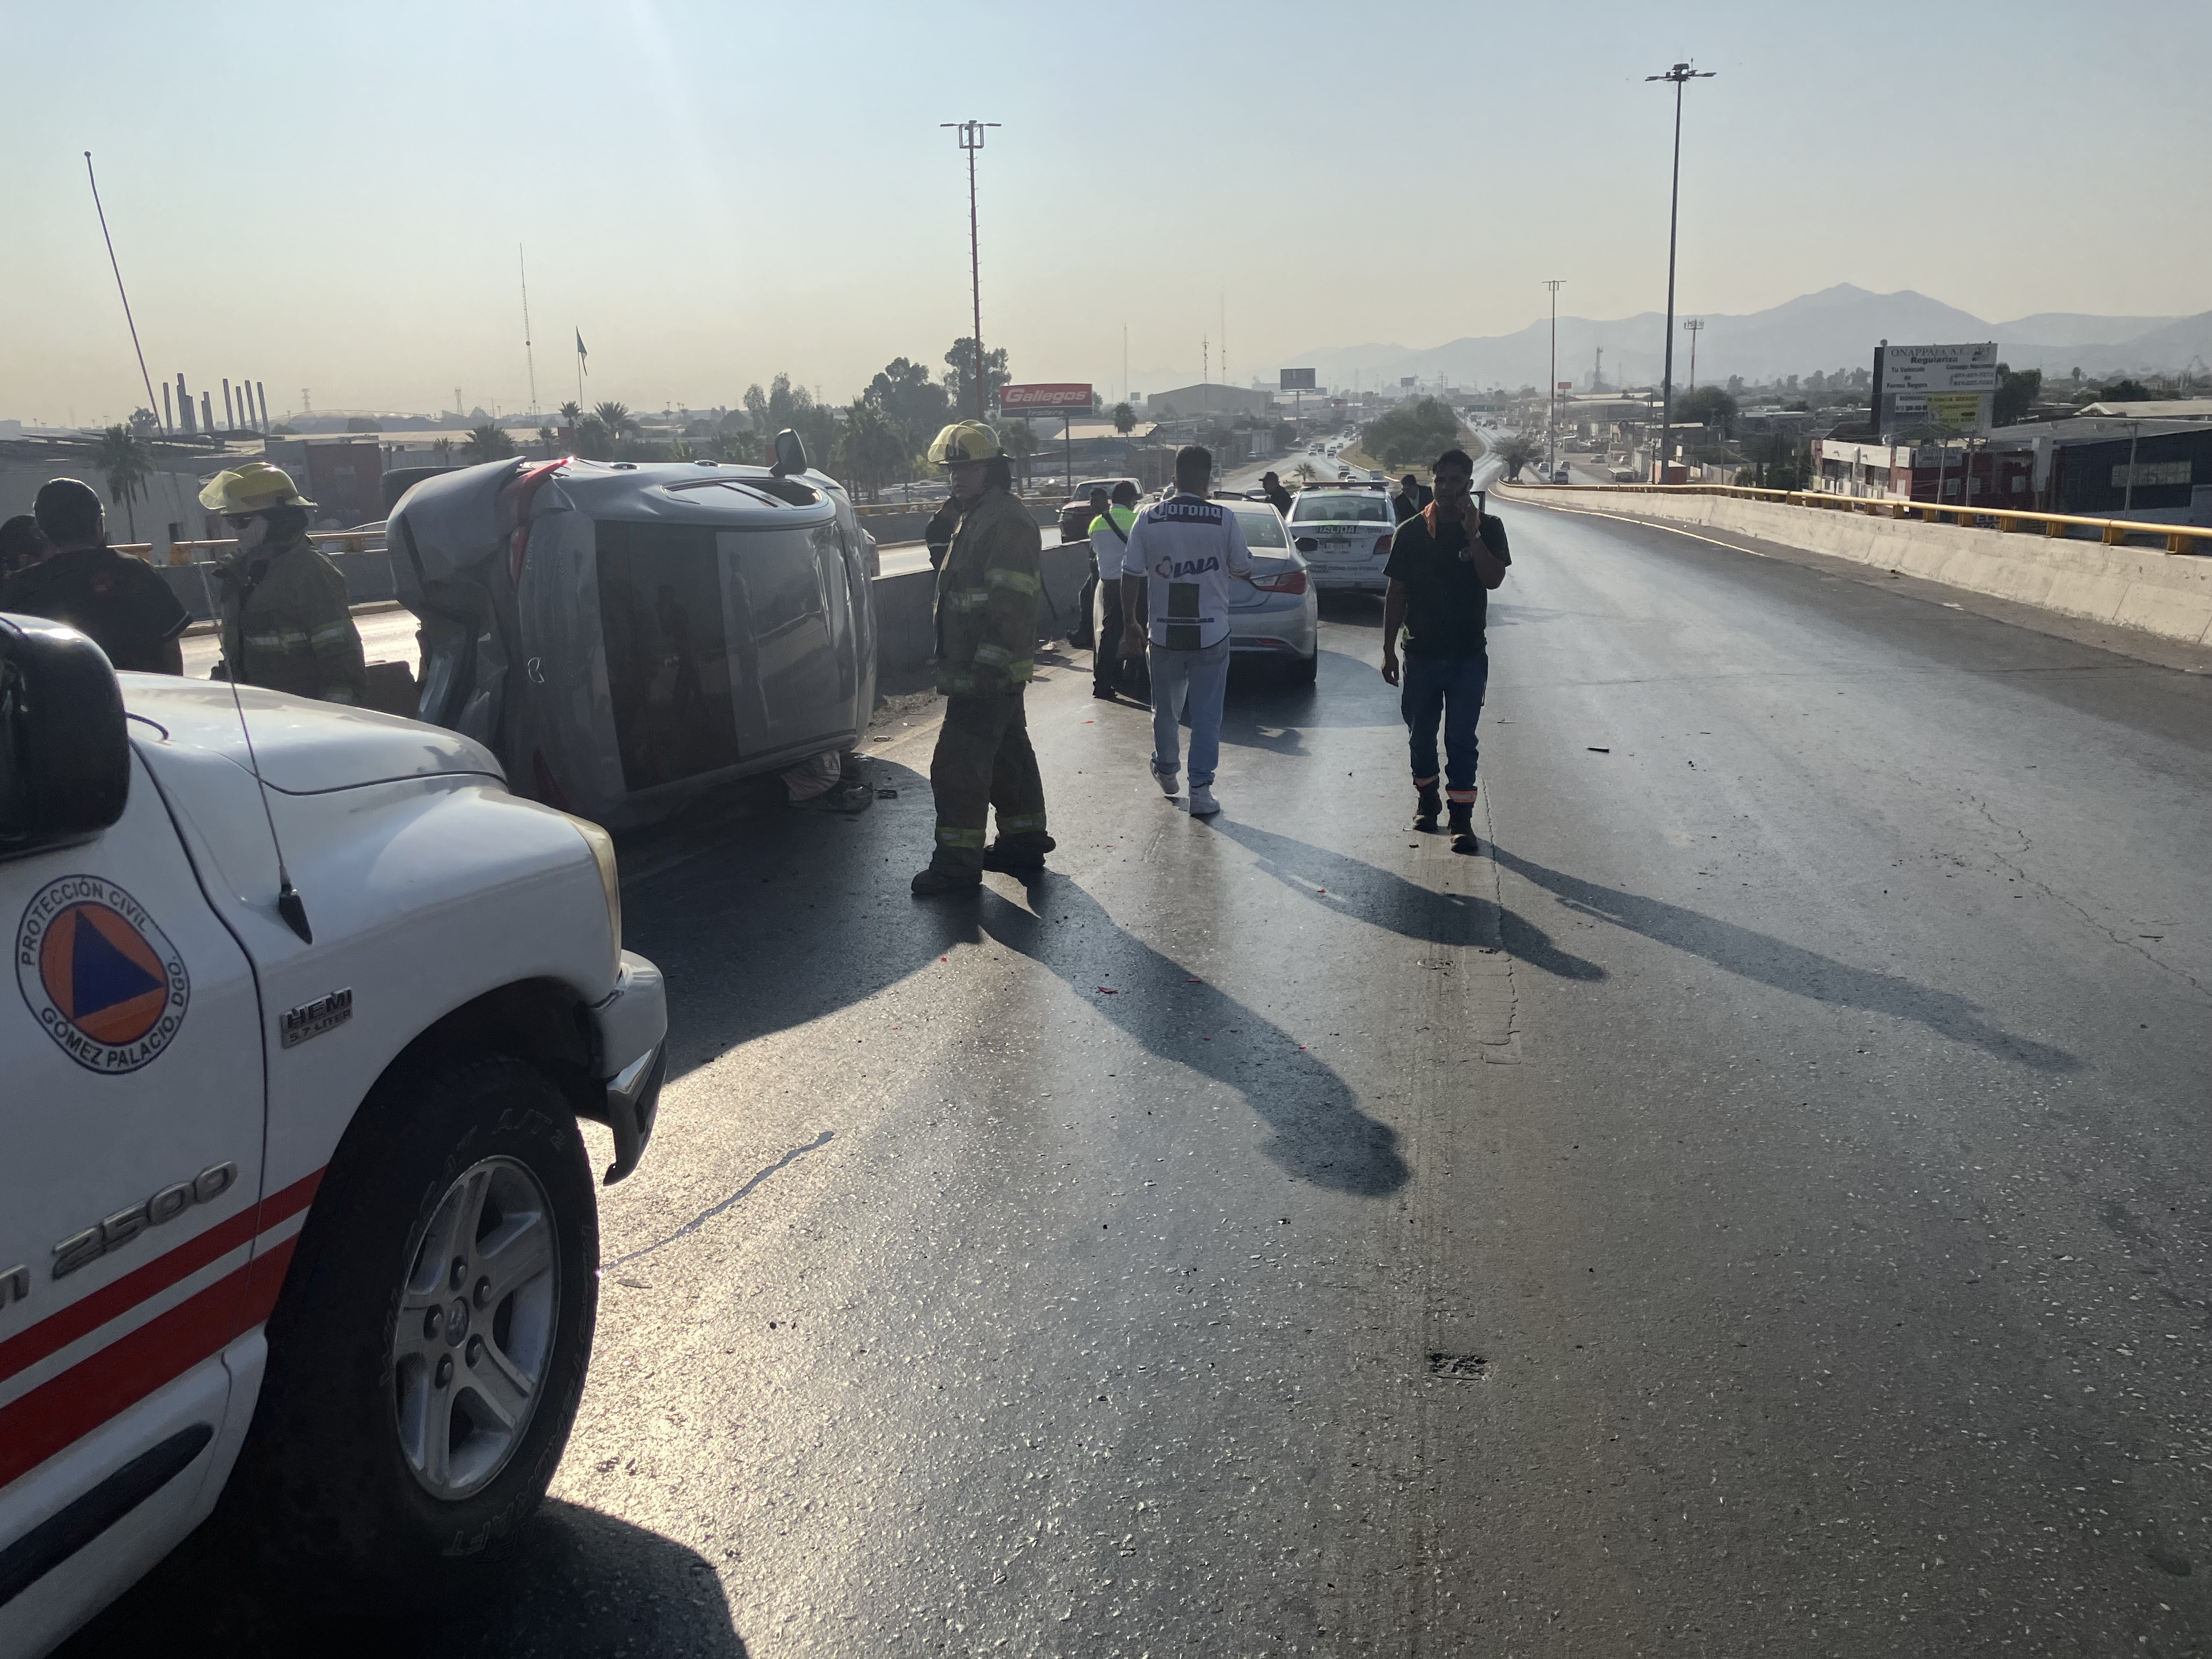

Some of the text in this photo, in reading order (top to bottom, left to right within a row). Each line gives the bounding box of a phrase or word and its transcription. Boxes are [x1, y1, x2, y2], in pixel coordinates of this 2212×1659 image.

[1005, 388, 1087, 404] Gallegos
[1149, 500, 1222, 521] Corona
[1313, 525, 1364, 534] VIALIDAD
[21, 877, 149, 966] PROTECCIÓN CIVIL
[286, 989, 353, 1029] HEMI
[314, 1009, 352, 1030] LITER
[52, 1160, 239, 1280] 2500
